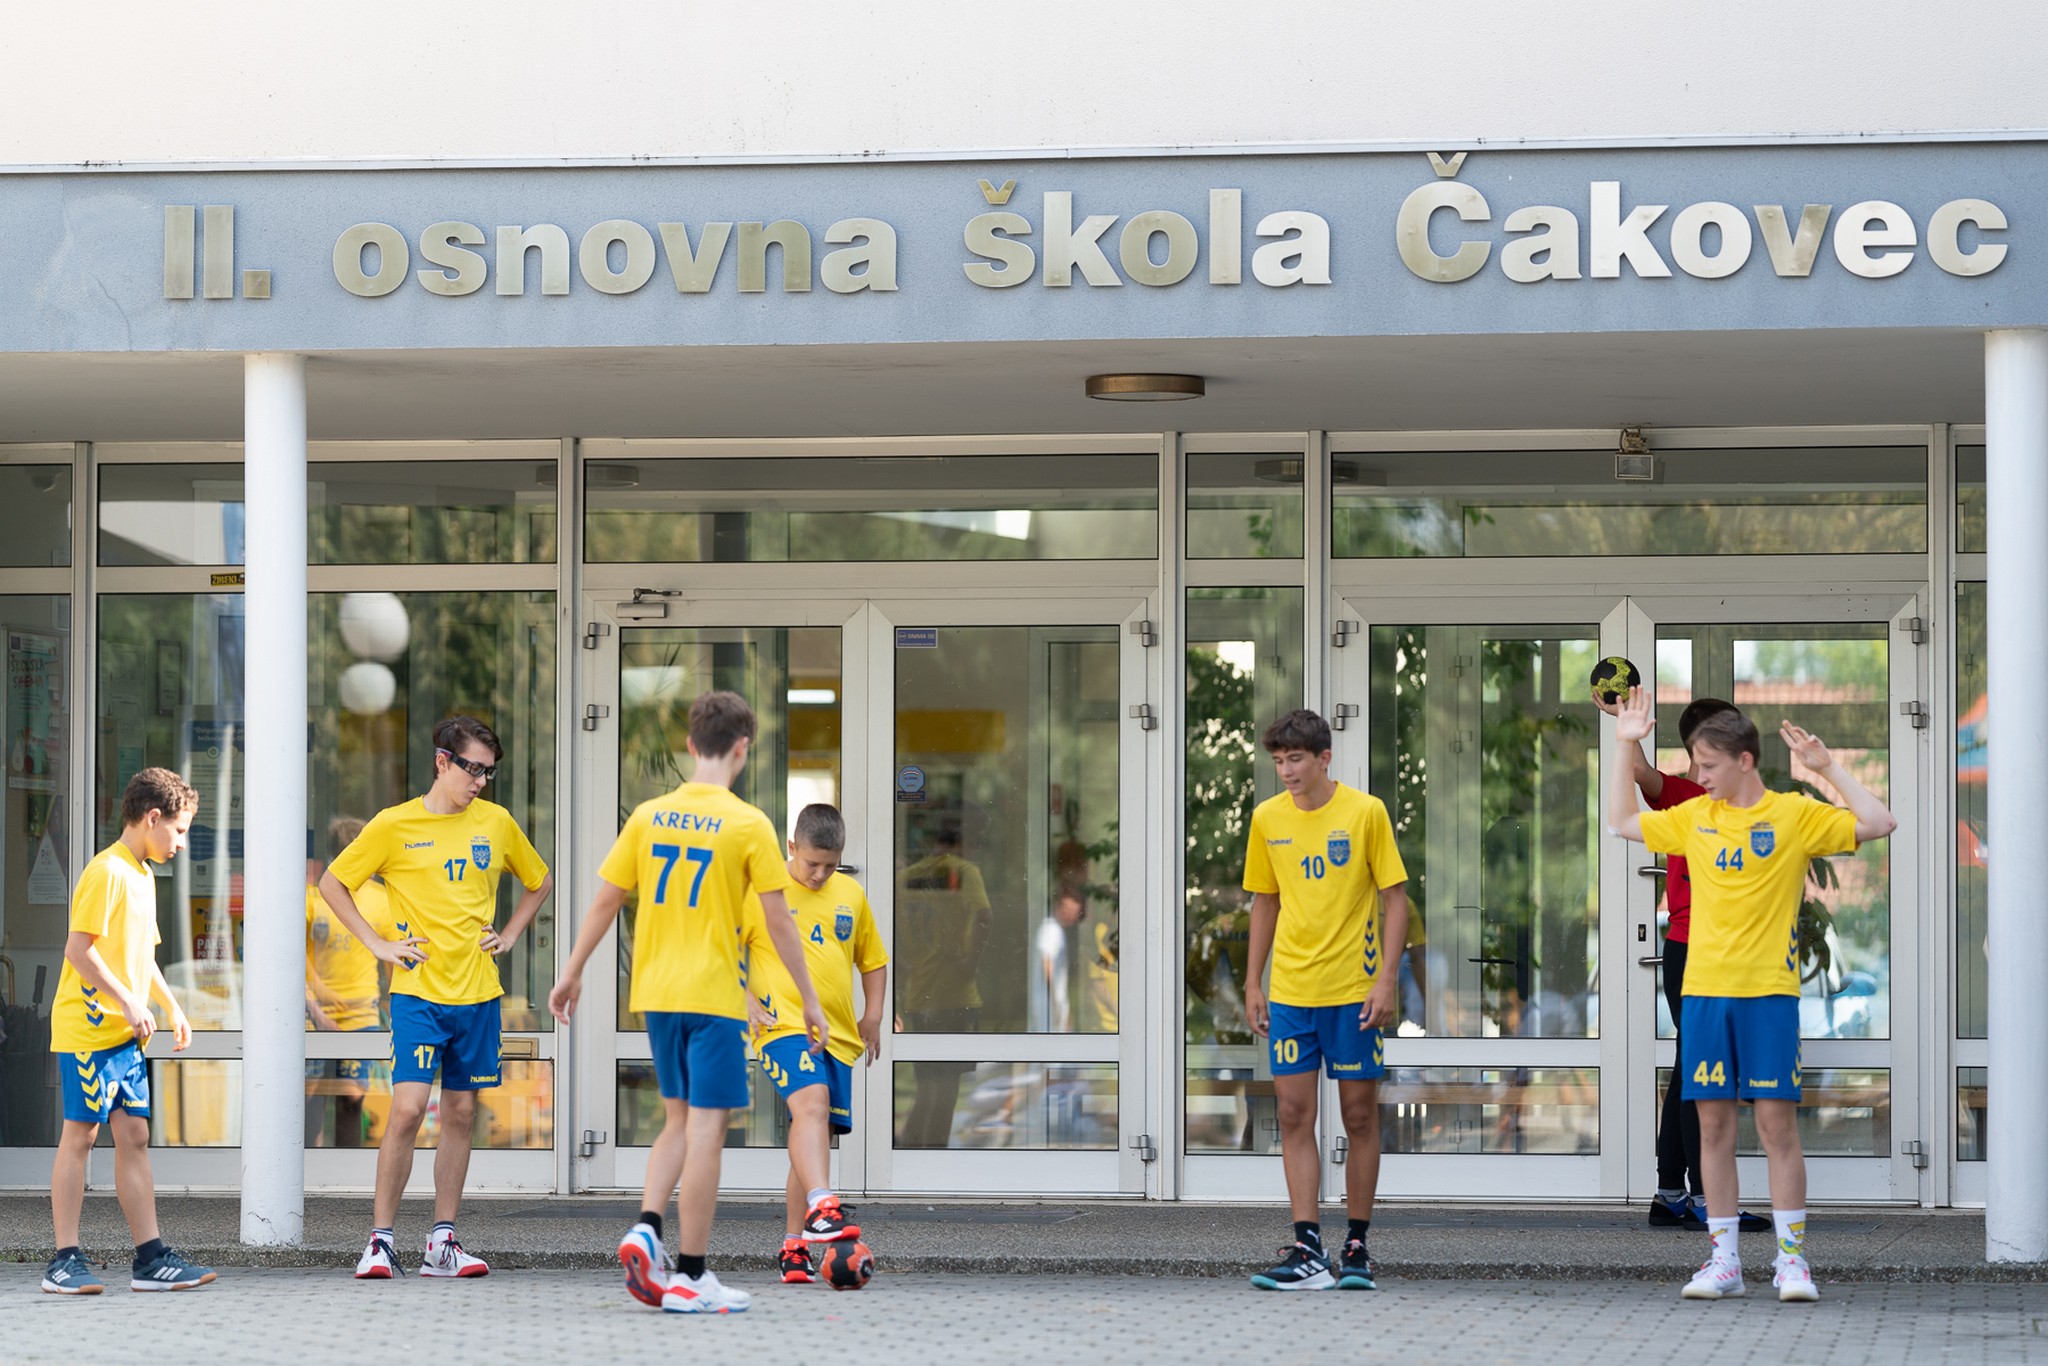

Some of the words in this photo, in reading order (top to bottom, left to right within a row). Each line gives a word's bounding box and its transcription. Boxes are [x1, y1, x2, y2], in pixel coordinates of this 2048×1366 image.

[163, 204, 272, 300] II.
[332, 217, 900, 299] osnovna
[962, 178, 1333, 289] škola
[1395, 151, 2009, 284] Čakovec
[652, 811, 722, 833] KREVH
[404, 840, 434, 850] hummel
[444, 858, 467, 882] 17
[1301, 855, 1325, 880] 10
[1715, 848, 1744, 872] 44
[651, 843, 713, 908] 77
[810, 924, 824, 945] 4
[413, 1045, 435, 1069] 17
[799, 1050, 816, 1073] 4
[1274, 1038, 1299, 1065] 10
[470, 1074, 498, 1083] hummel
[1333, 1062, 1362, 1071] hummel
[1693, 1060, 1726, 1087] 44
[1749, 1078, 1778, 1088] hummel
